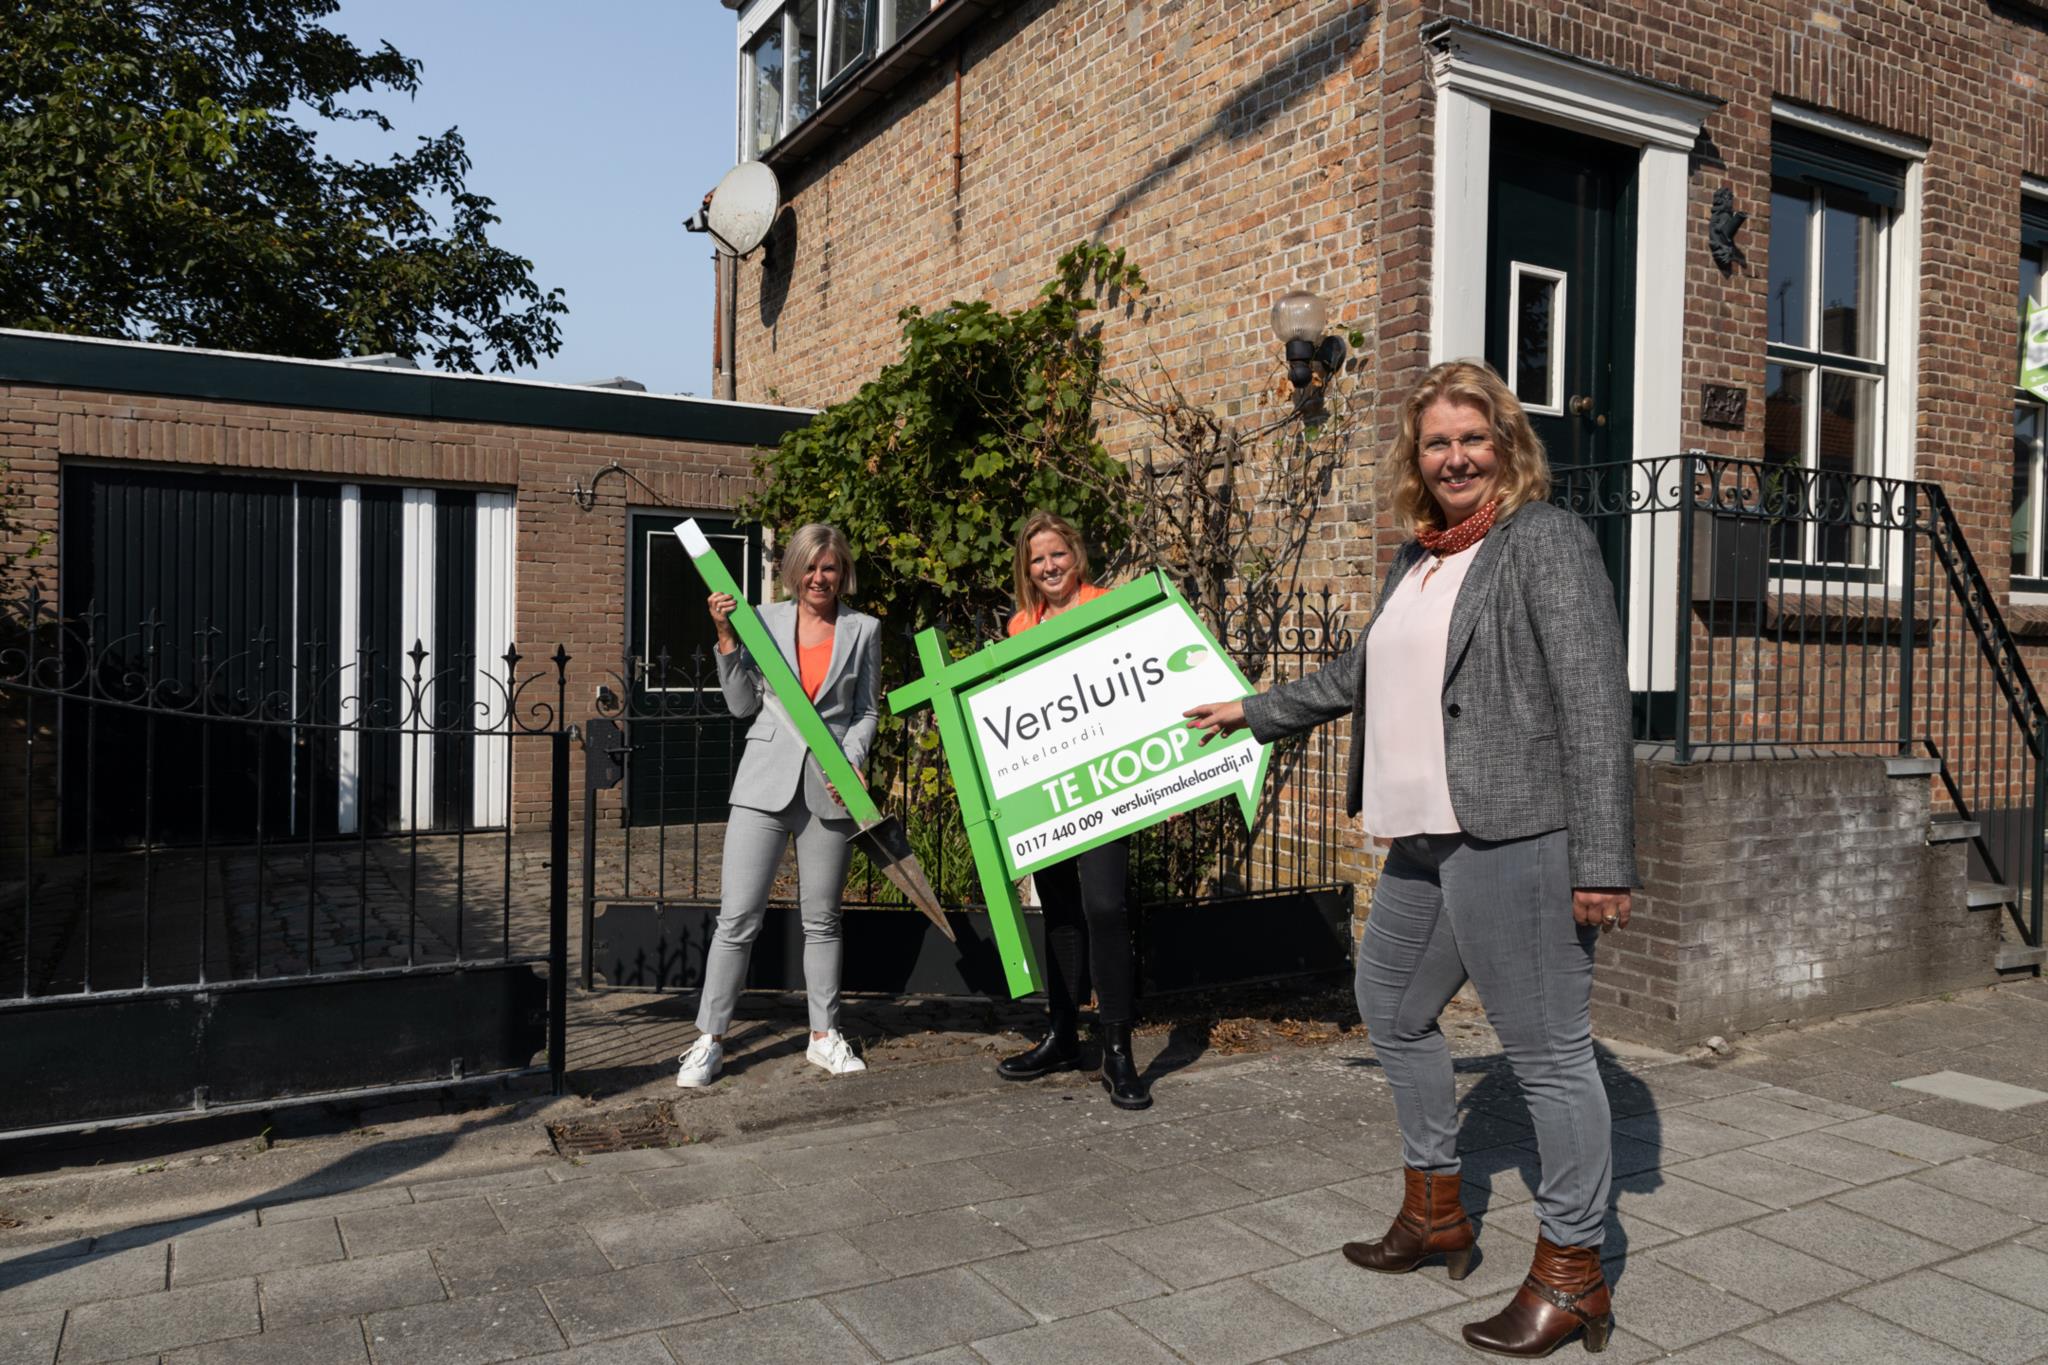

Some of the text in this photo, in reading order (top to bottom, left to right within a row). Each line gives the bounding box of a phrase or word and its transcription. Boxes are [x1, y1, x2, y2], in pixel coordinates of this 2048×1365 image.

[983, 652, 1164, 749] Versluijs
[997, 722, 1105, 777] makelaardij
[1042, 727, 1190, 813] TE KOOP
[1016, 748, 1253, 857] 0117 440 009 versluijsmakelaardij.nl
